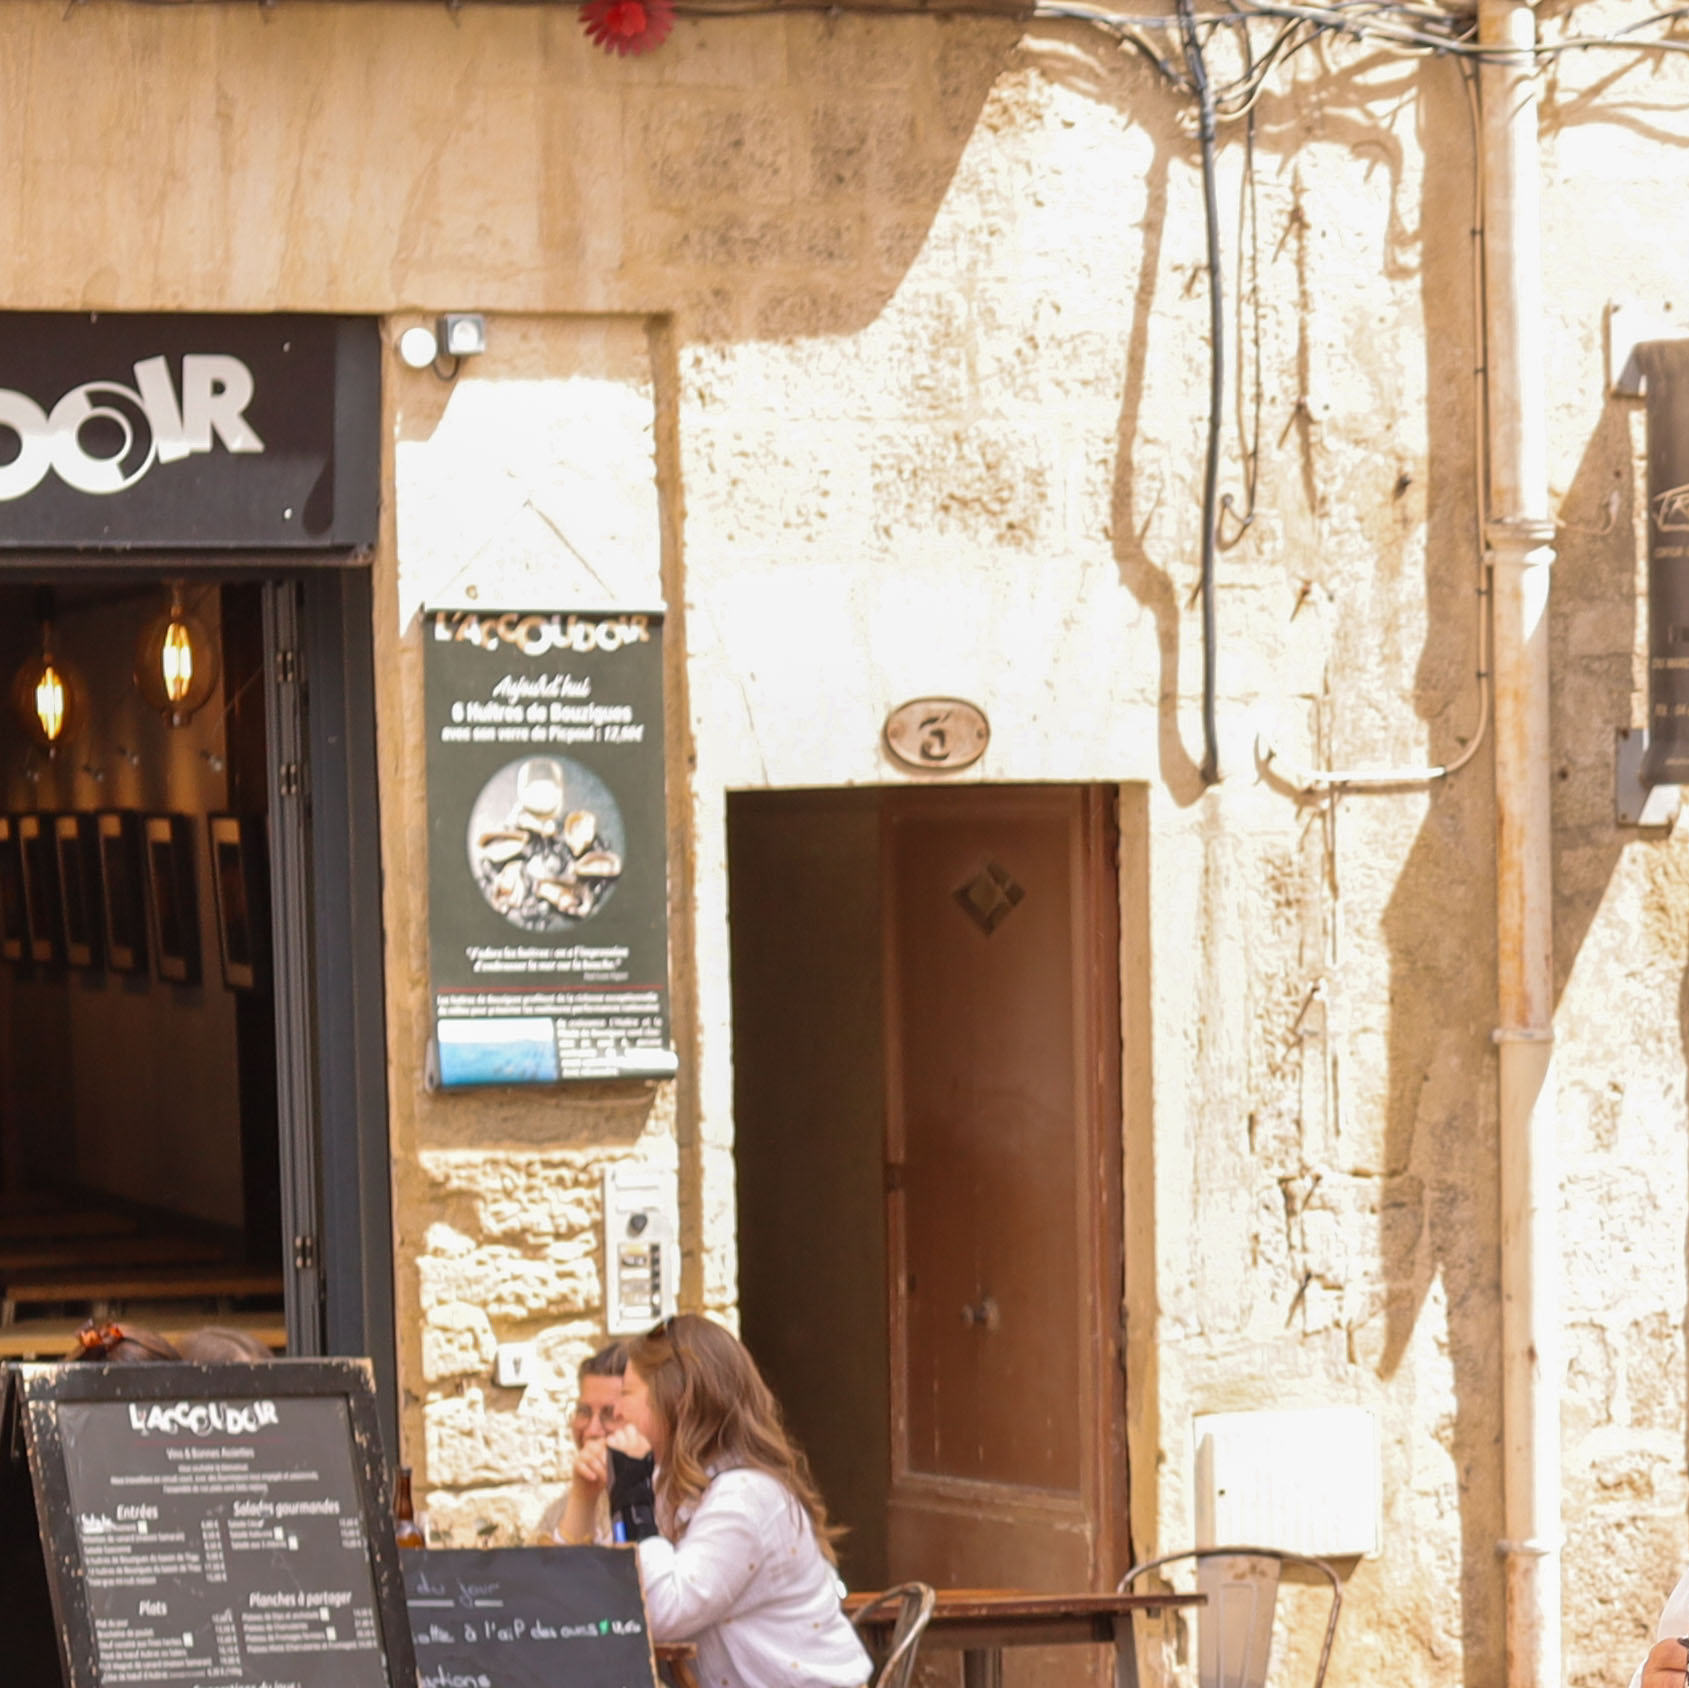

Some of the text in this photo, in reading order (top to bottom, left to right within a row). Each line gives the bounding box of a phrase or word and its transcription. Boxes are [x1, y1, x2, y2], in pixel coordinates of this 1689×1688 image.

[117, 1503, 158, 1520] Entrées
[275, 1498, 340, 1518] gourmandes
[416, 1572, 446, 1596] du
[249, 1591, 296, 1608] Planches
[307, 1590, 352, 1608] partager
[139, 1600, 167, 1617] Plats
